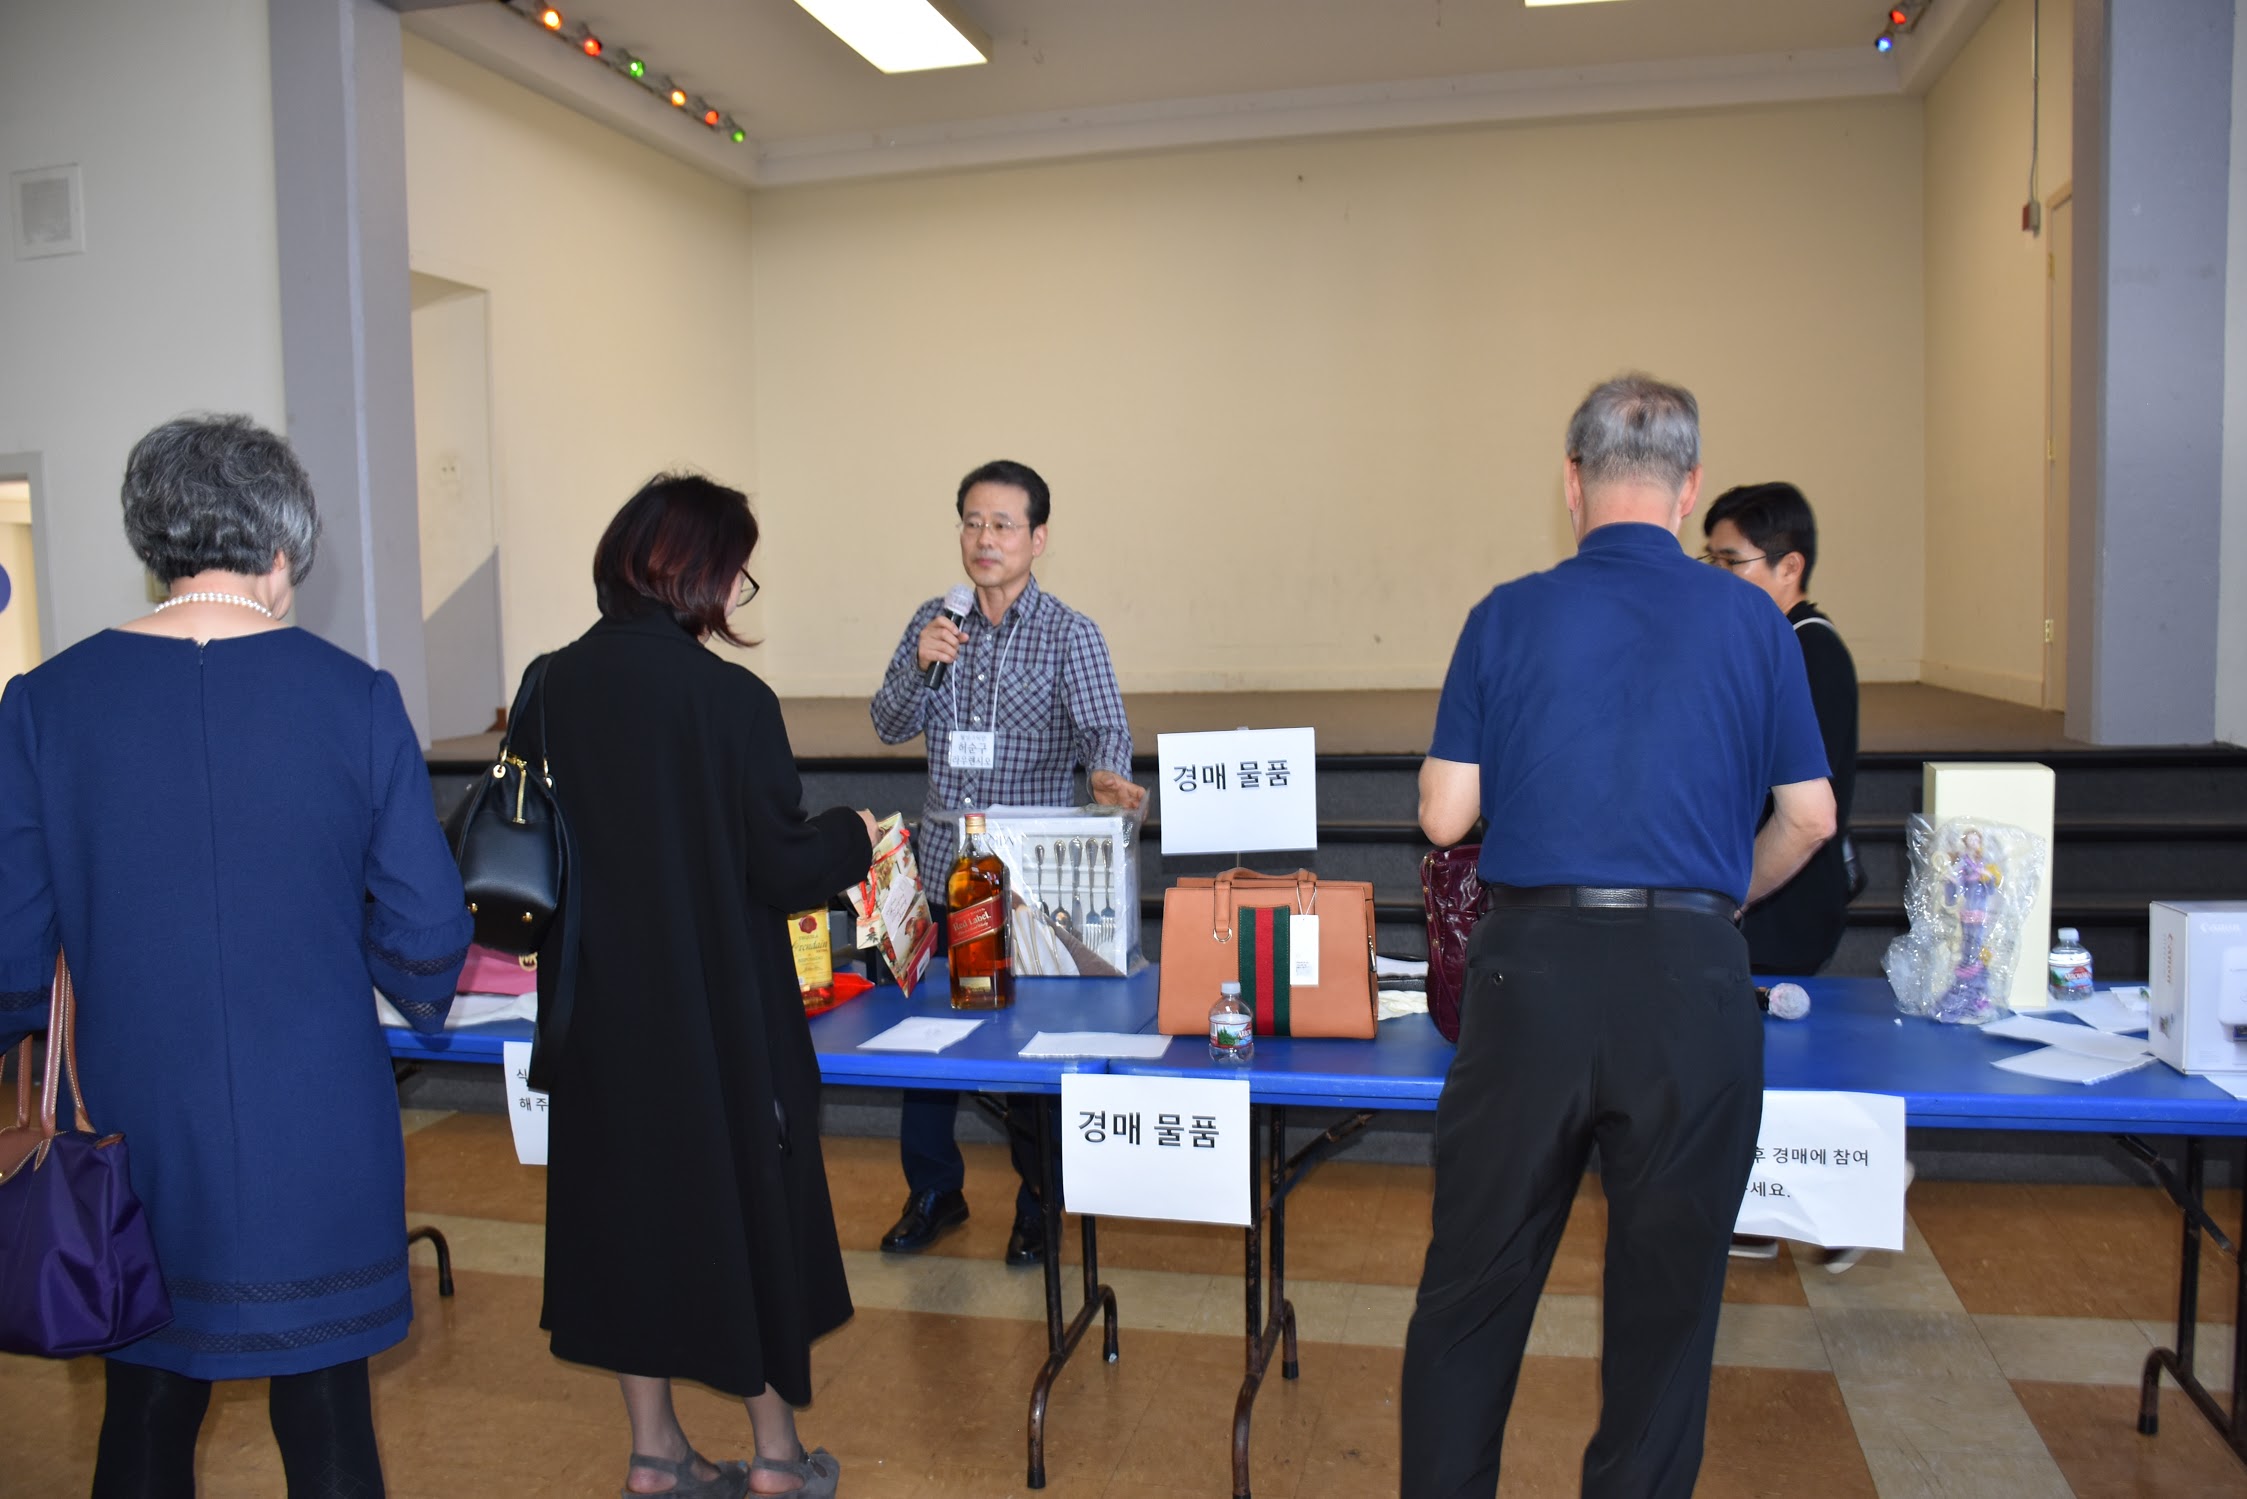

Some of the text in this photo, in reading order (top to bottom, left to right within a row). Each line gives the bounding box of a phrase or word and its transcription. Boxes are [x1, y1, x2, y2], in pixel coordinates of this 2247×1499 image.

[1173, 759, 1291, 792] 경매 물품
[953, 919, 968, 932] Red
[2200, 921, 2242, 934] Canon
[519, 1097, 532, 1111] 해
[1078, 1110, 1219, 1148] 경매 물품
[1772, 1147, 1827, 1165] 경매에
[1832, 1148, 1869, 1167] 참여
[1746, 1181, 1791, 1198] 세요.
